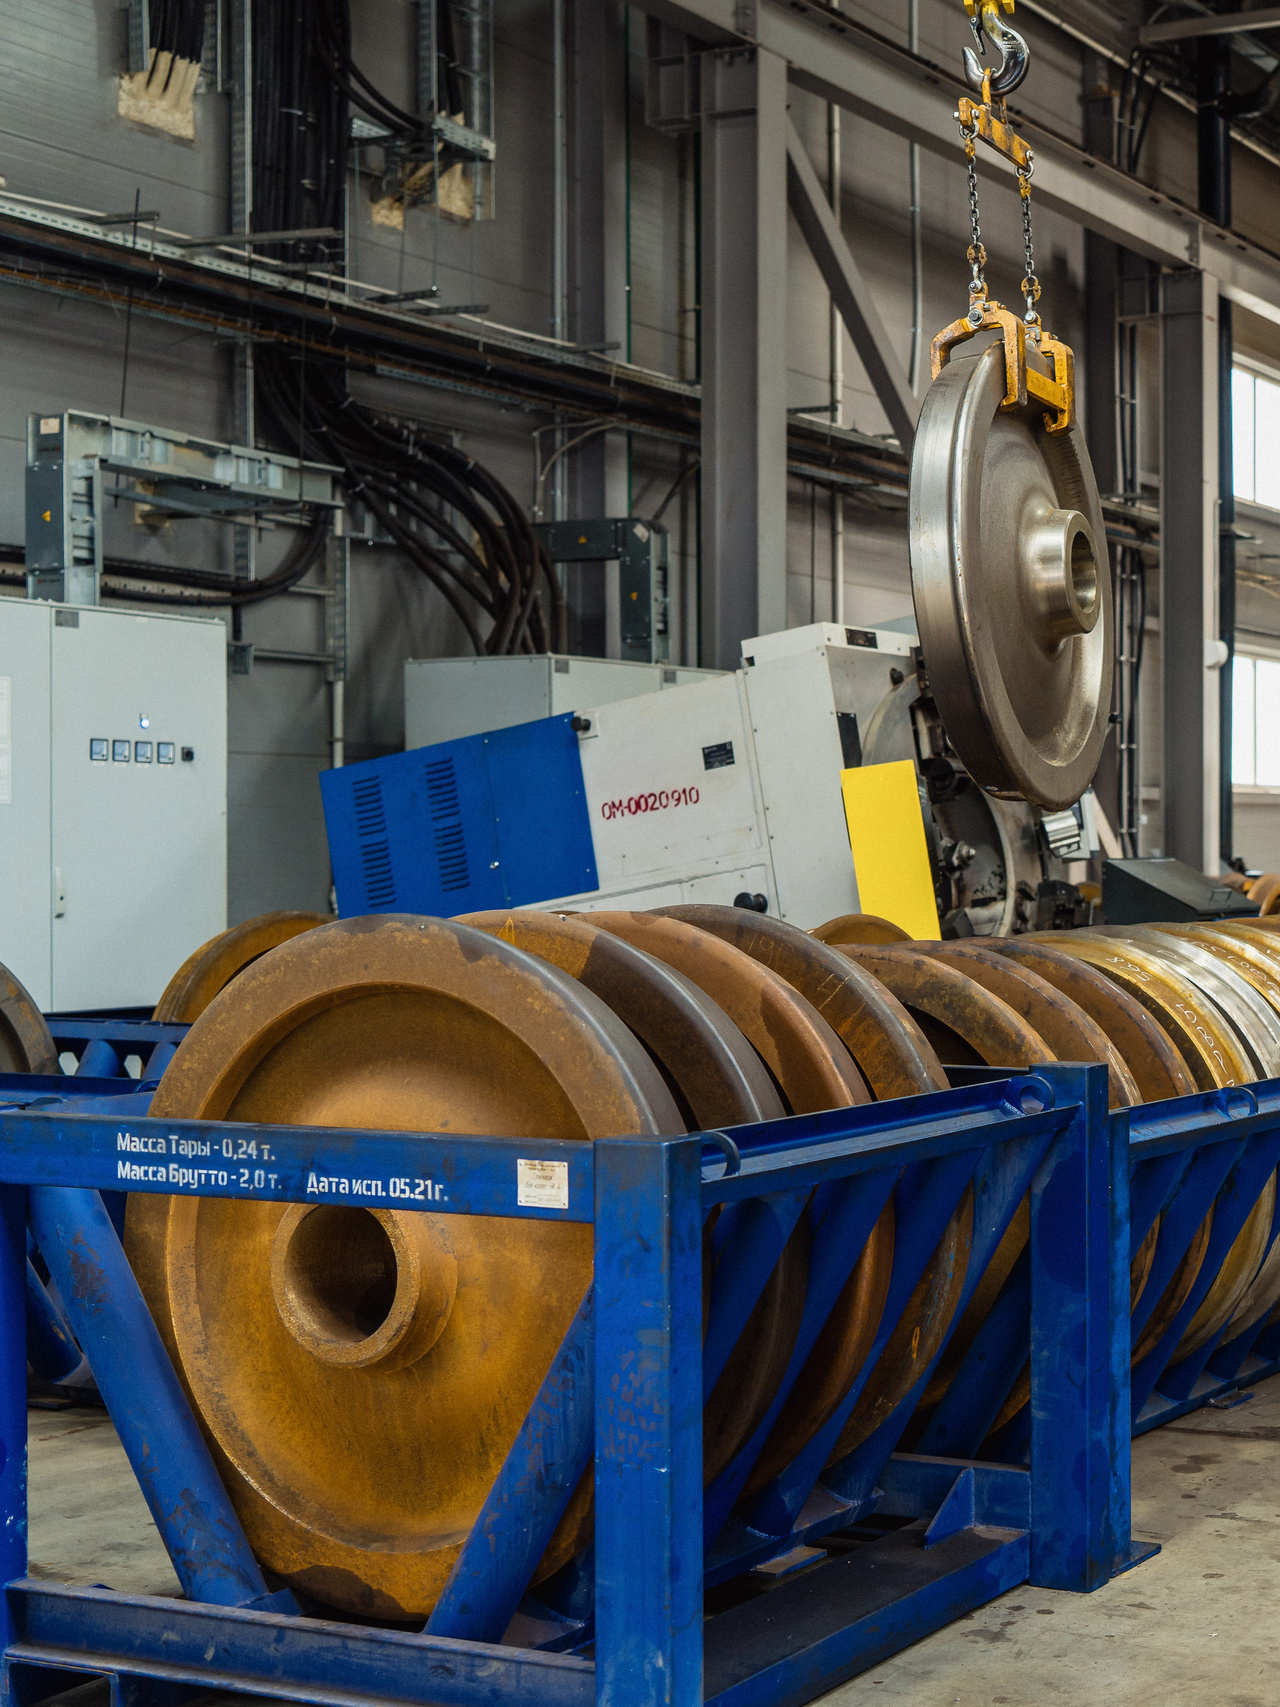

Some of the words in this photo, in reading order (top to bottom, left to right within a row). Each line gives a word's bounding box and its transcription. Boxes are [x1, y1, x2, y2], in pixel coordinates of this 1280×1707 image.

[117, 1132, 166, 1153] Масса
[169, 1135, 211, 1158] Тары
[222, 1139, 257, 1160] 0,24
[260, 1145, 276, 1160] т.
[117, 1160, 166, 1182] Масса
[169, 1163, 228, 1189] Брутто
[239, 1169, 265, 1189] 2,0
[268, 1174, 282, 1189] т.
[307, 1172, 349, 1194] Дата
[352, 1178, 387, 1196] исп.
[389, 1177, 432, 1200] 05.21
